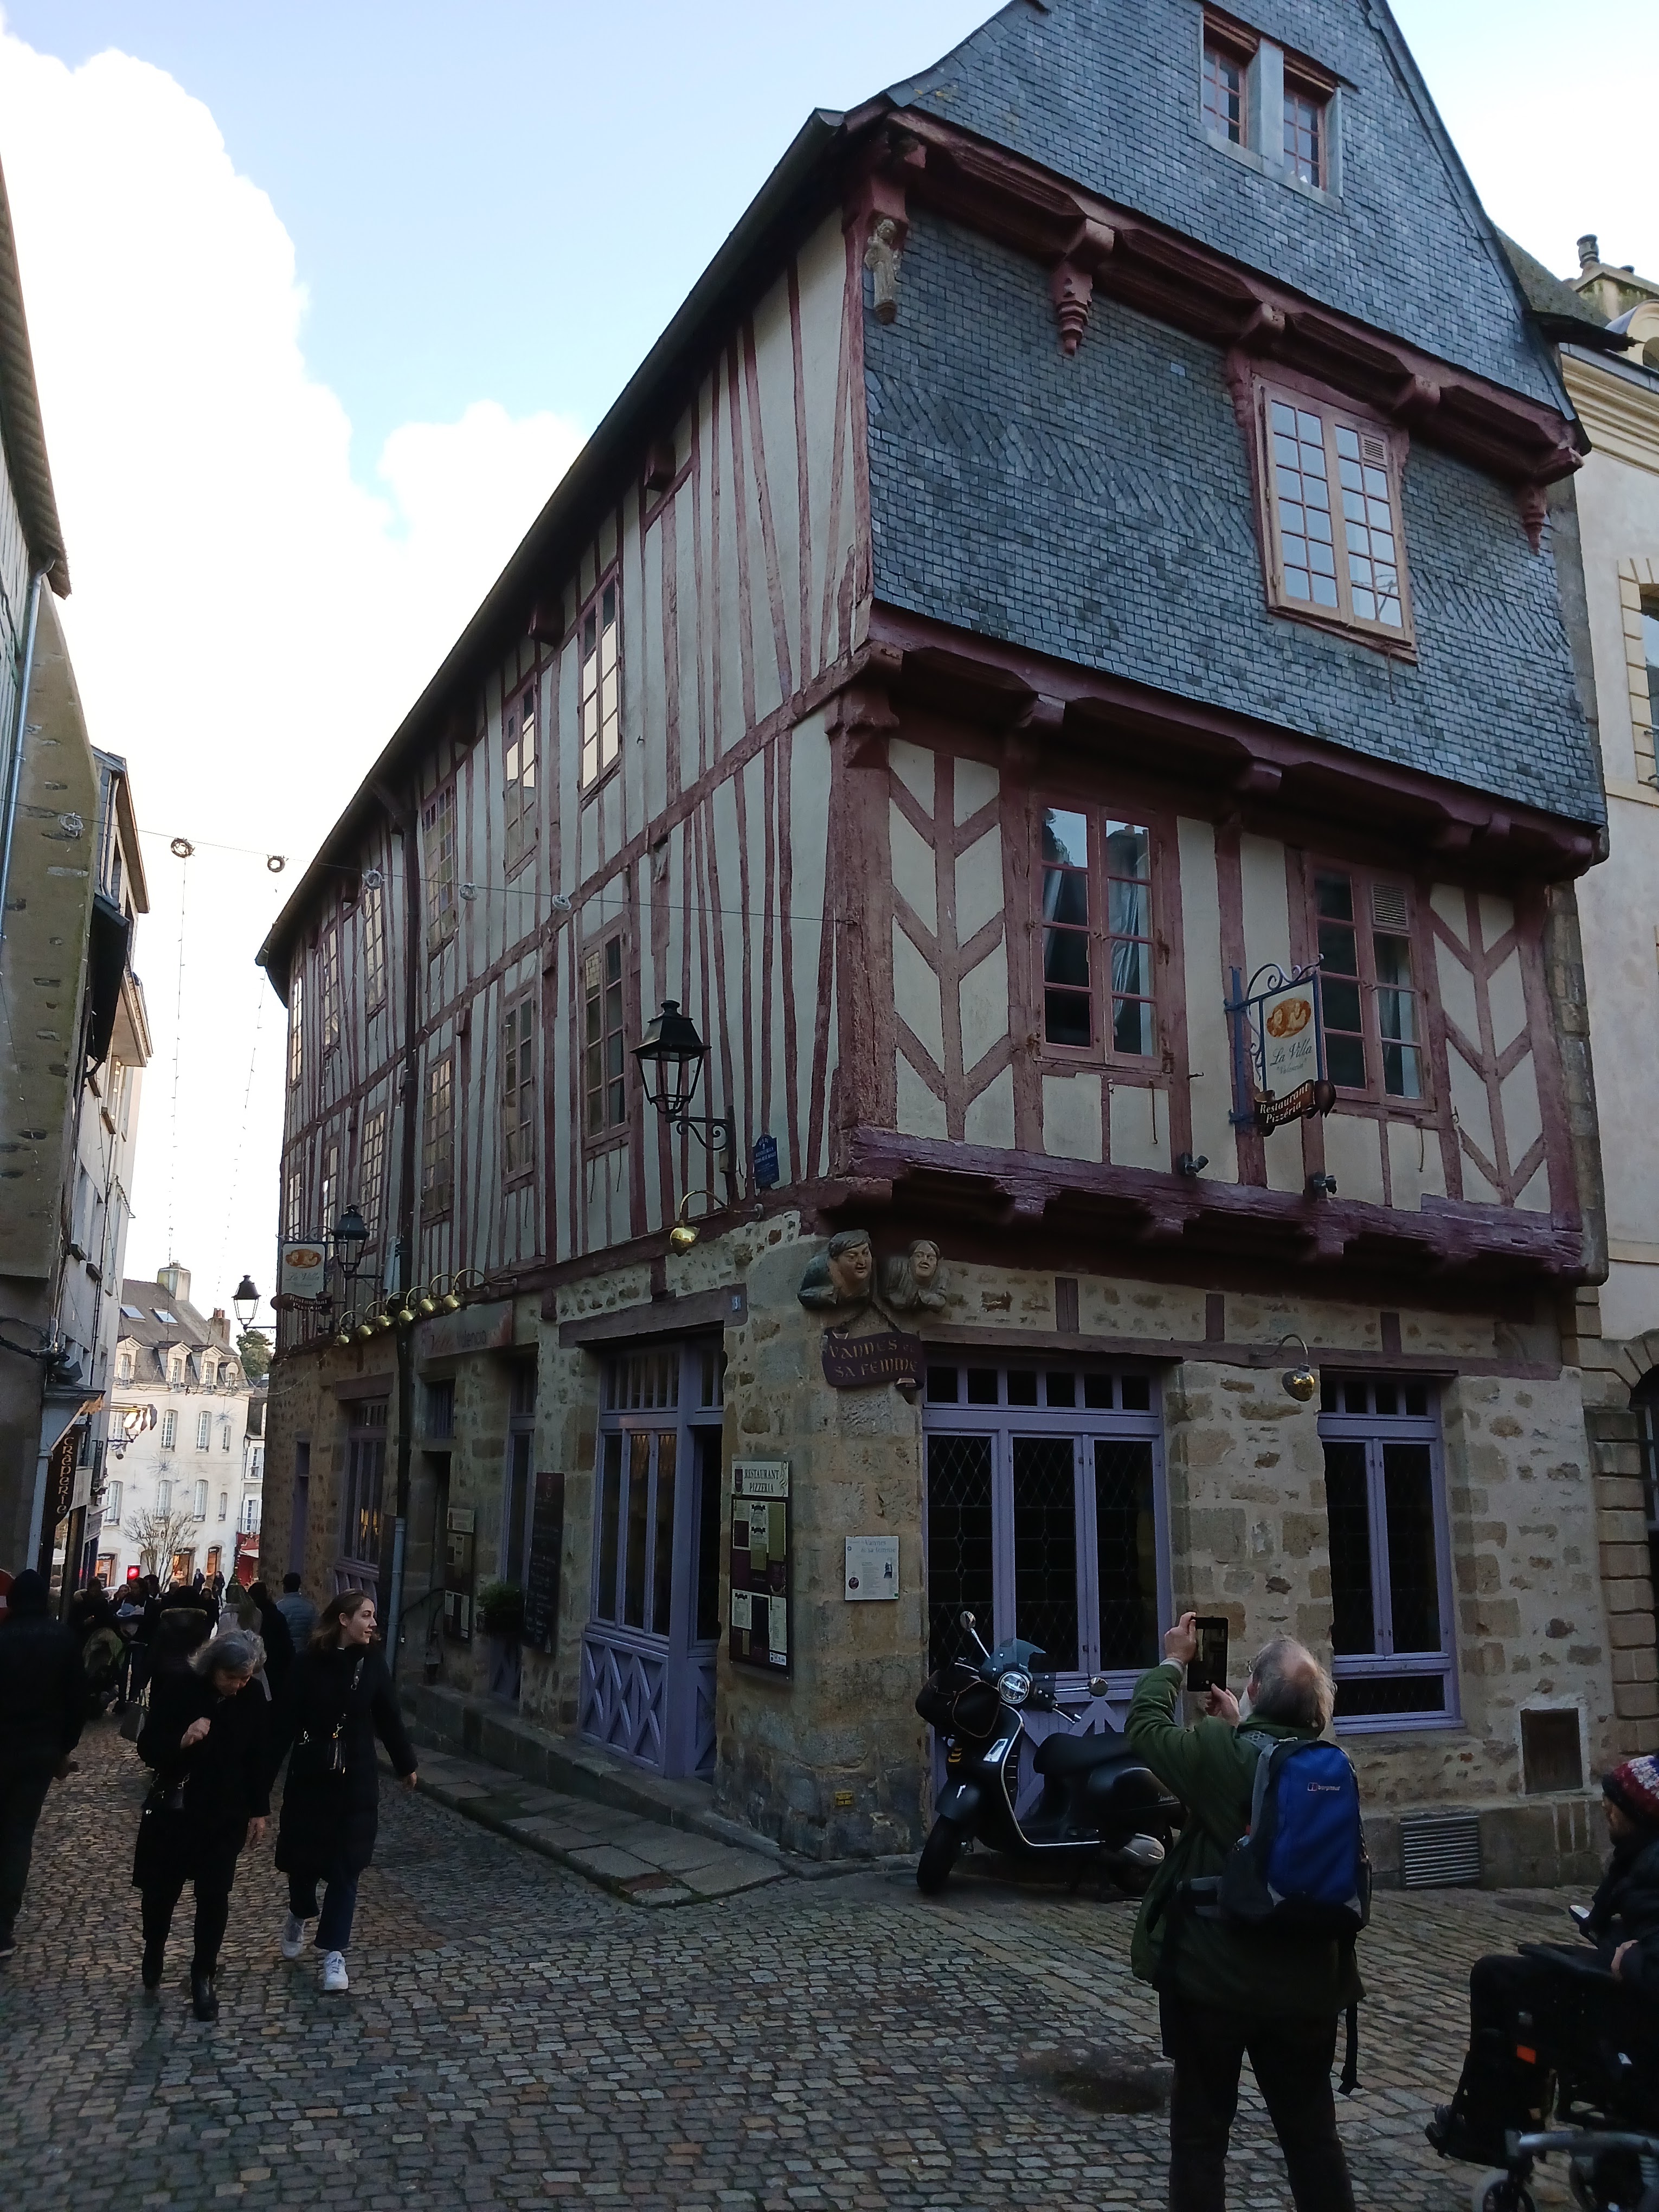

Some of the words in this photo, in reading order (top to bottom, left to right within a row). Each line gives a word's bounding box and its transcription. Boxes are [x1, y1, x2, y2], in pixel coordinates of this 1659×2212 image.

[1270, 1047, 1286, 1066] La
[1289, 1038, 1313, 1060] Villa
[1259, 1083, 1309, 1114] Restaurant
[1266, 1101, 1302, 1124] Pizzéria
[829, 1340, 898, 1359] VANNES
[834, 1366, 856, 1378] SA
[860, 1358, 918, 1375] FEMME
[744, 1469, 779, 1480] RESTAURANT
[749, 1482, 774, 1493] PIZZERIA
